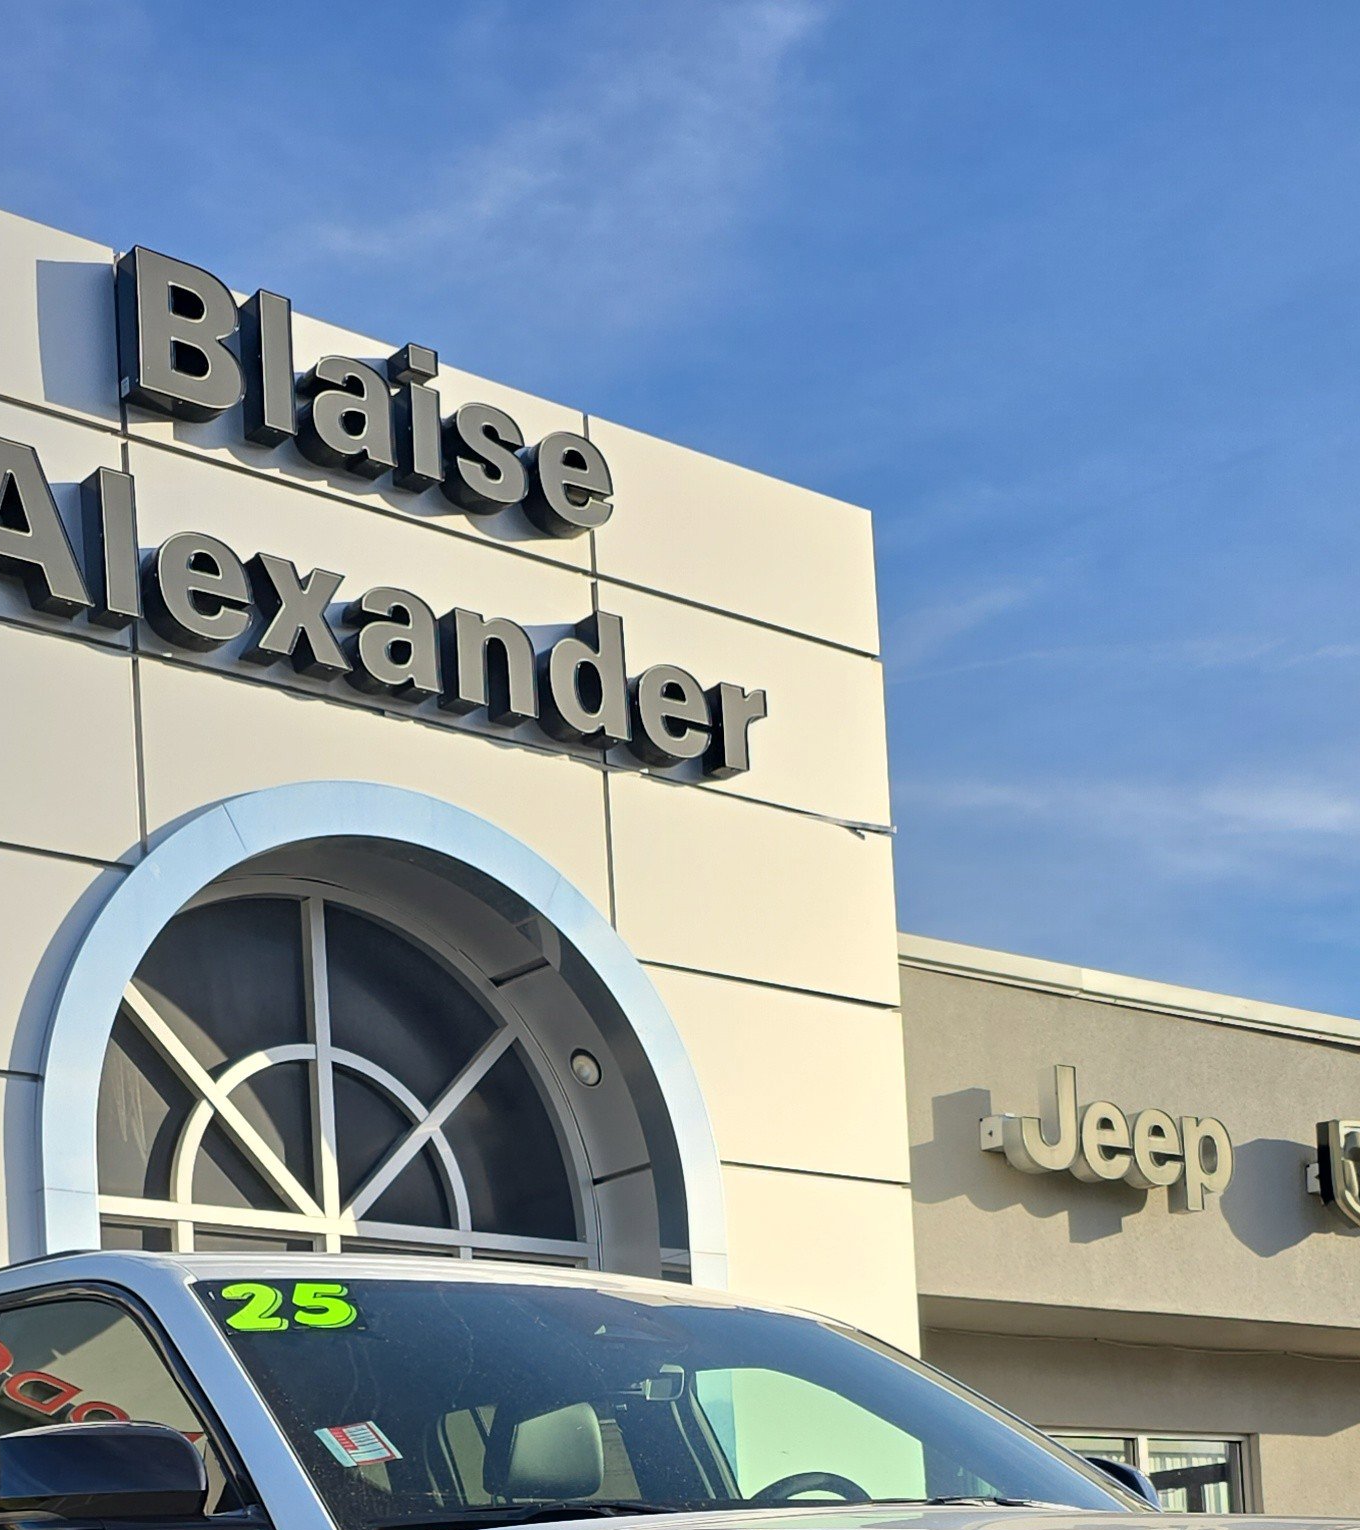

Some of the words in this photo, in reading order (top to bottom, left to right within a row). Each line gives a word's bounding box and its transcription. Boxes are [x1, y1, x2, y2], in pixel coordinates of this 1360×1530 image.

[118, 244, 614, 537] Blaise
[1003, 1064, 1234, 1211] Jeep
[221, 1282, 358, 1332] 25
